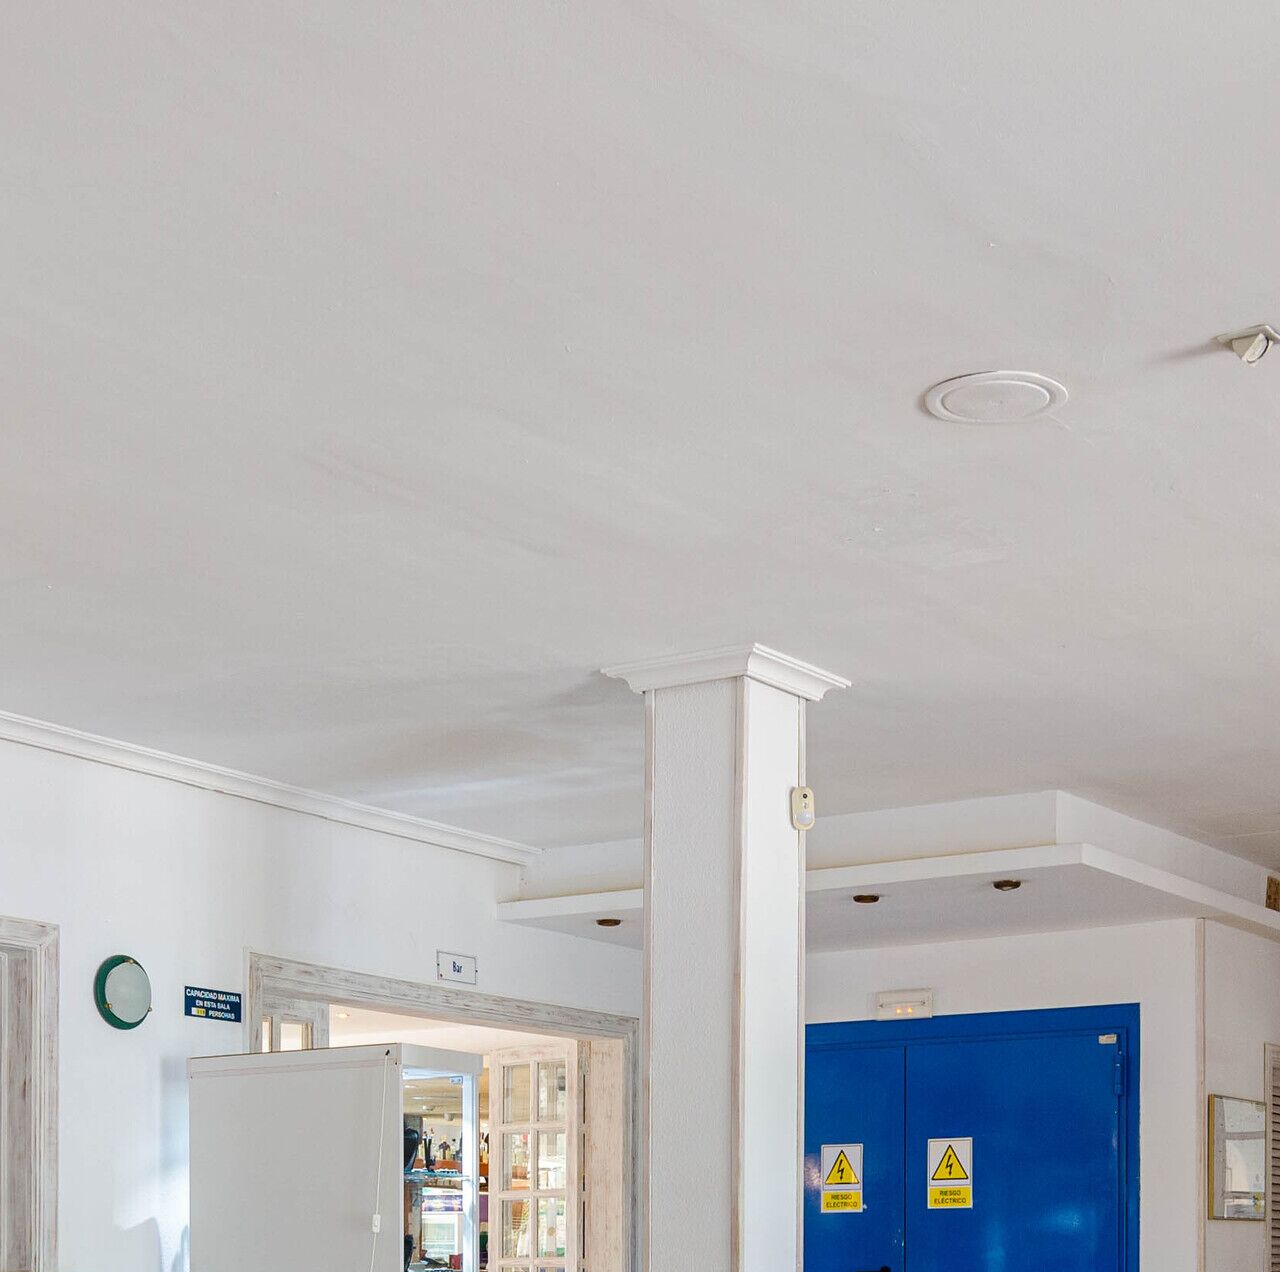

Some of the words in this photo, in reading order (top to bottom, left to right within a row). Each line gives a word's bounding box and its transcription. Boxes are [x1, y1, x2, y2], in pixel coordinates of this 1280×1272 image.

[452, 960, 463, 974] Bar
[186, 988, 217, 1000] CAPACIDAD
[195, 999, 203, 1007] EN
[204, 1000, 217, 1009] ESTA
[217, 1002, 231, 1011] SALA
[208, 1010, 236, 1020] PERSONAS
